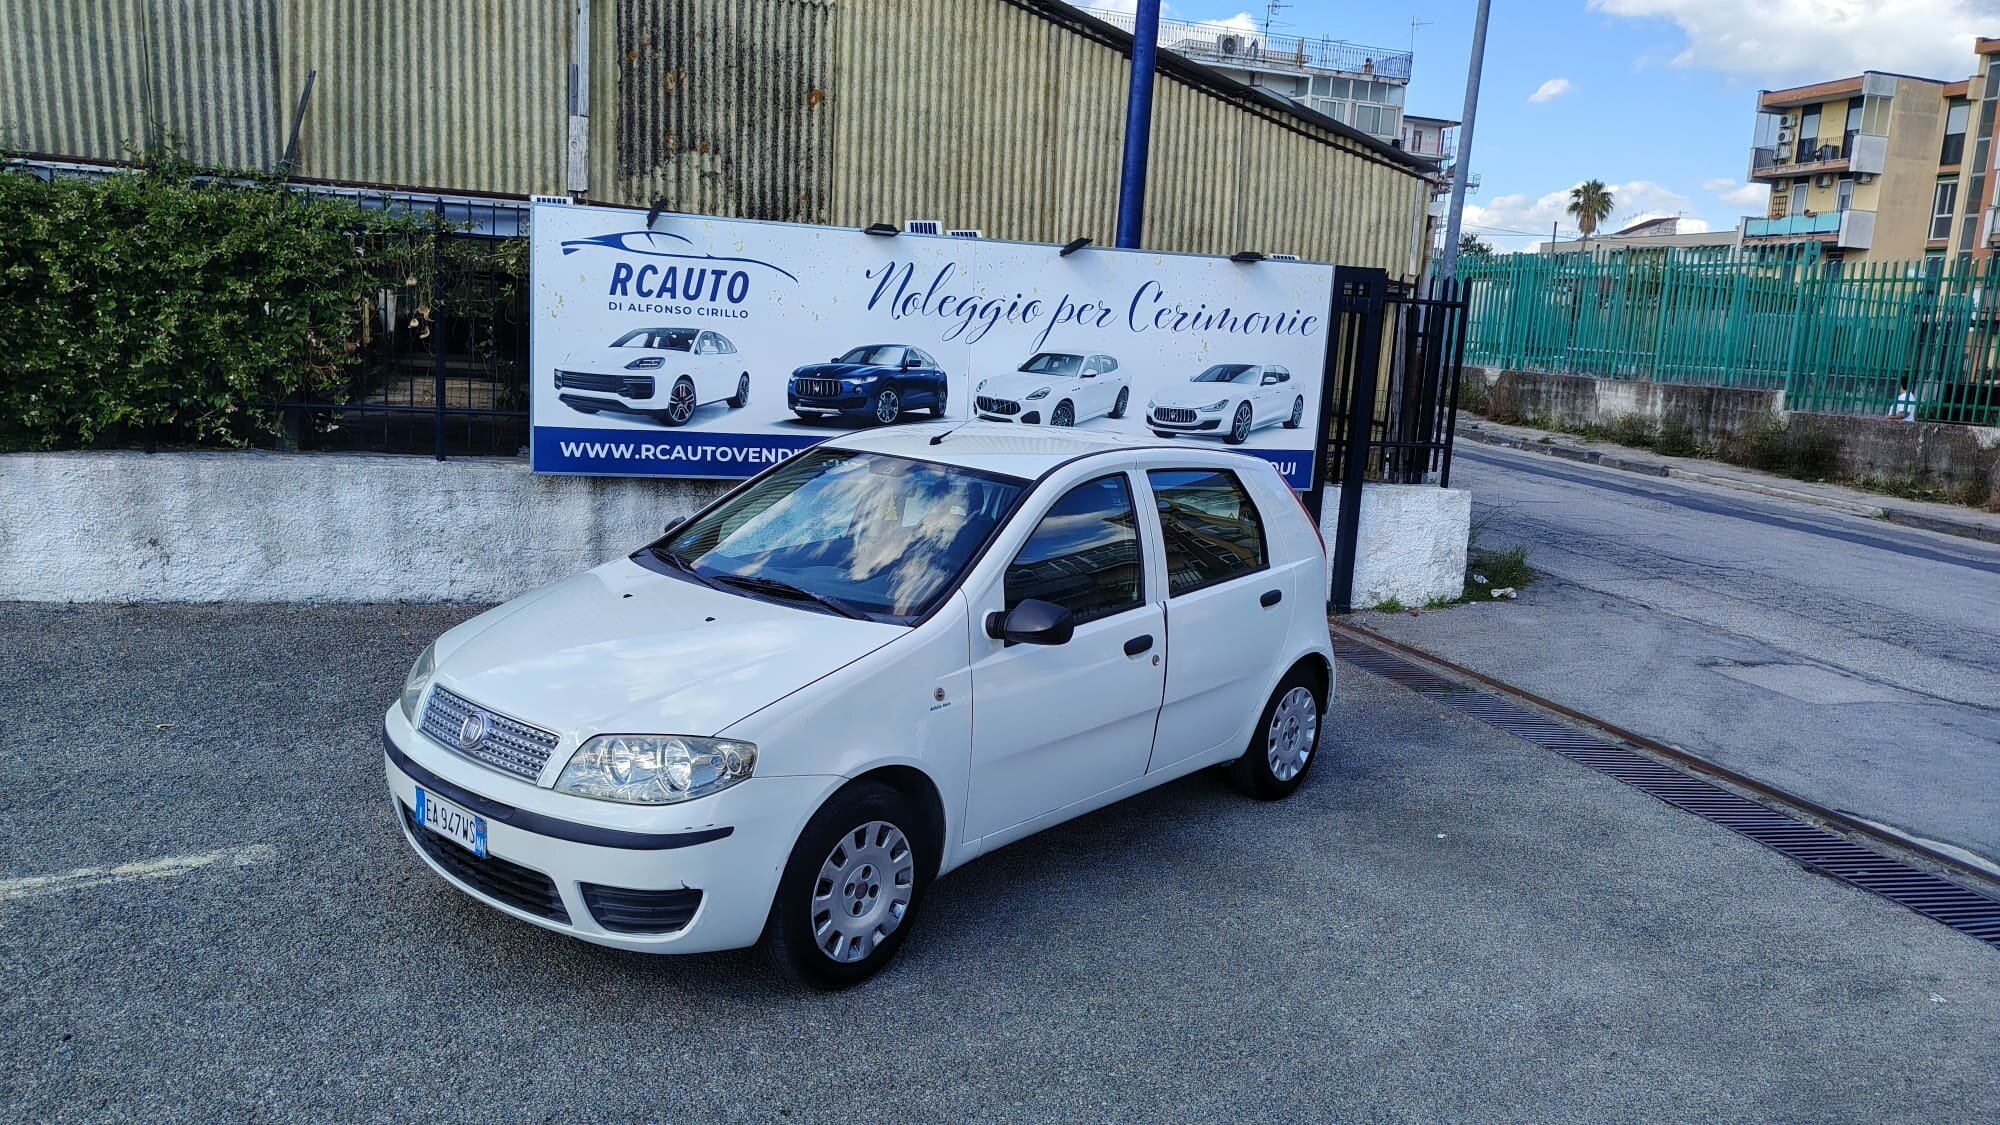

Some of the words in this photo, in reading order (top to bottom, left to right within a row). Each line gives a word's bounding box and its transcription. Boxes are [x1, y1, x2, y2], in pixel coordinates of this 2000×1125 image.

[609, 262, 750, 304] RCAUTO
[608, 301, 622, 311] DI
[628, 303, 692, 315] ALFONSO
[697, 307, 749, 318] CIRILLO
[866, 261, 1043, 345] Noleggio
[1031, 292, 1118, 354] per
[1128, 279, 1320, 337] Cerimonie
[560, 441, 805, 463] WWW.RCAUTOVEND
